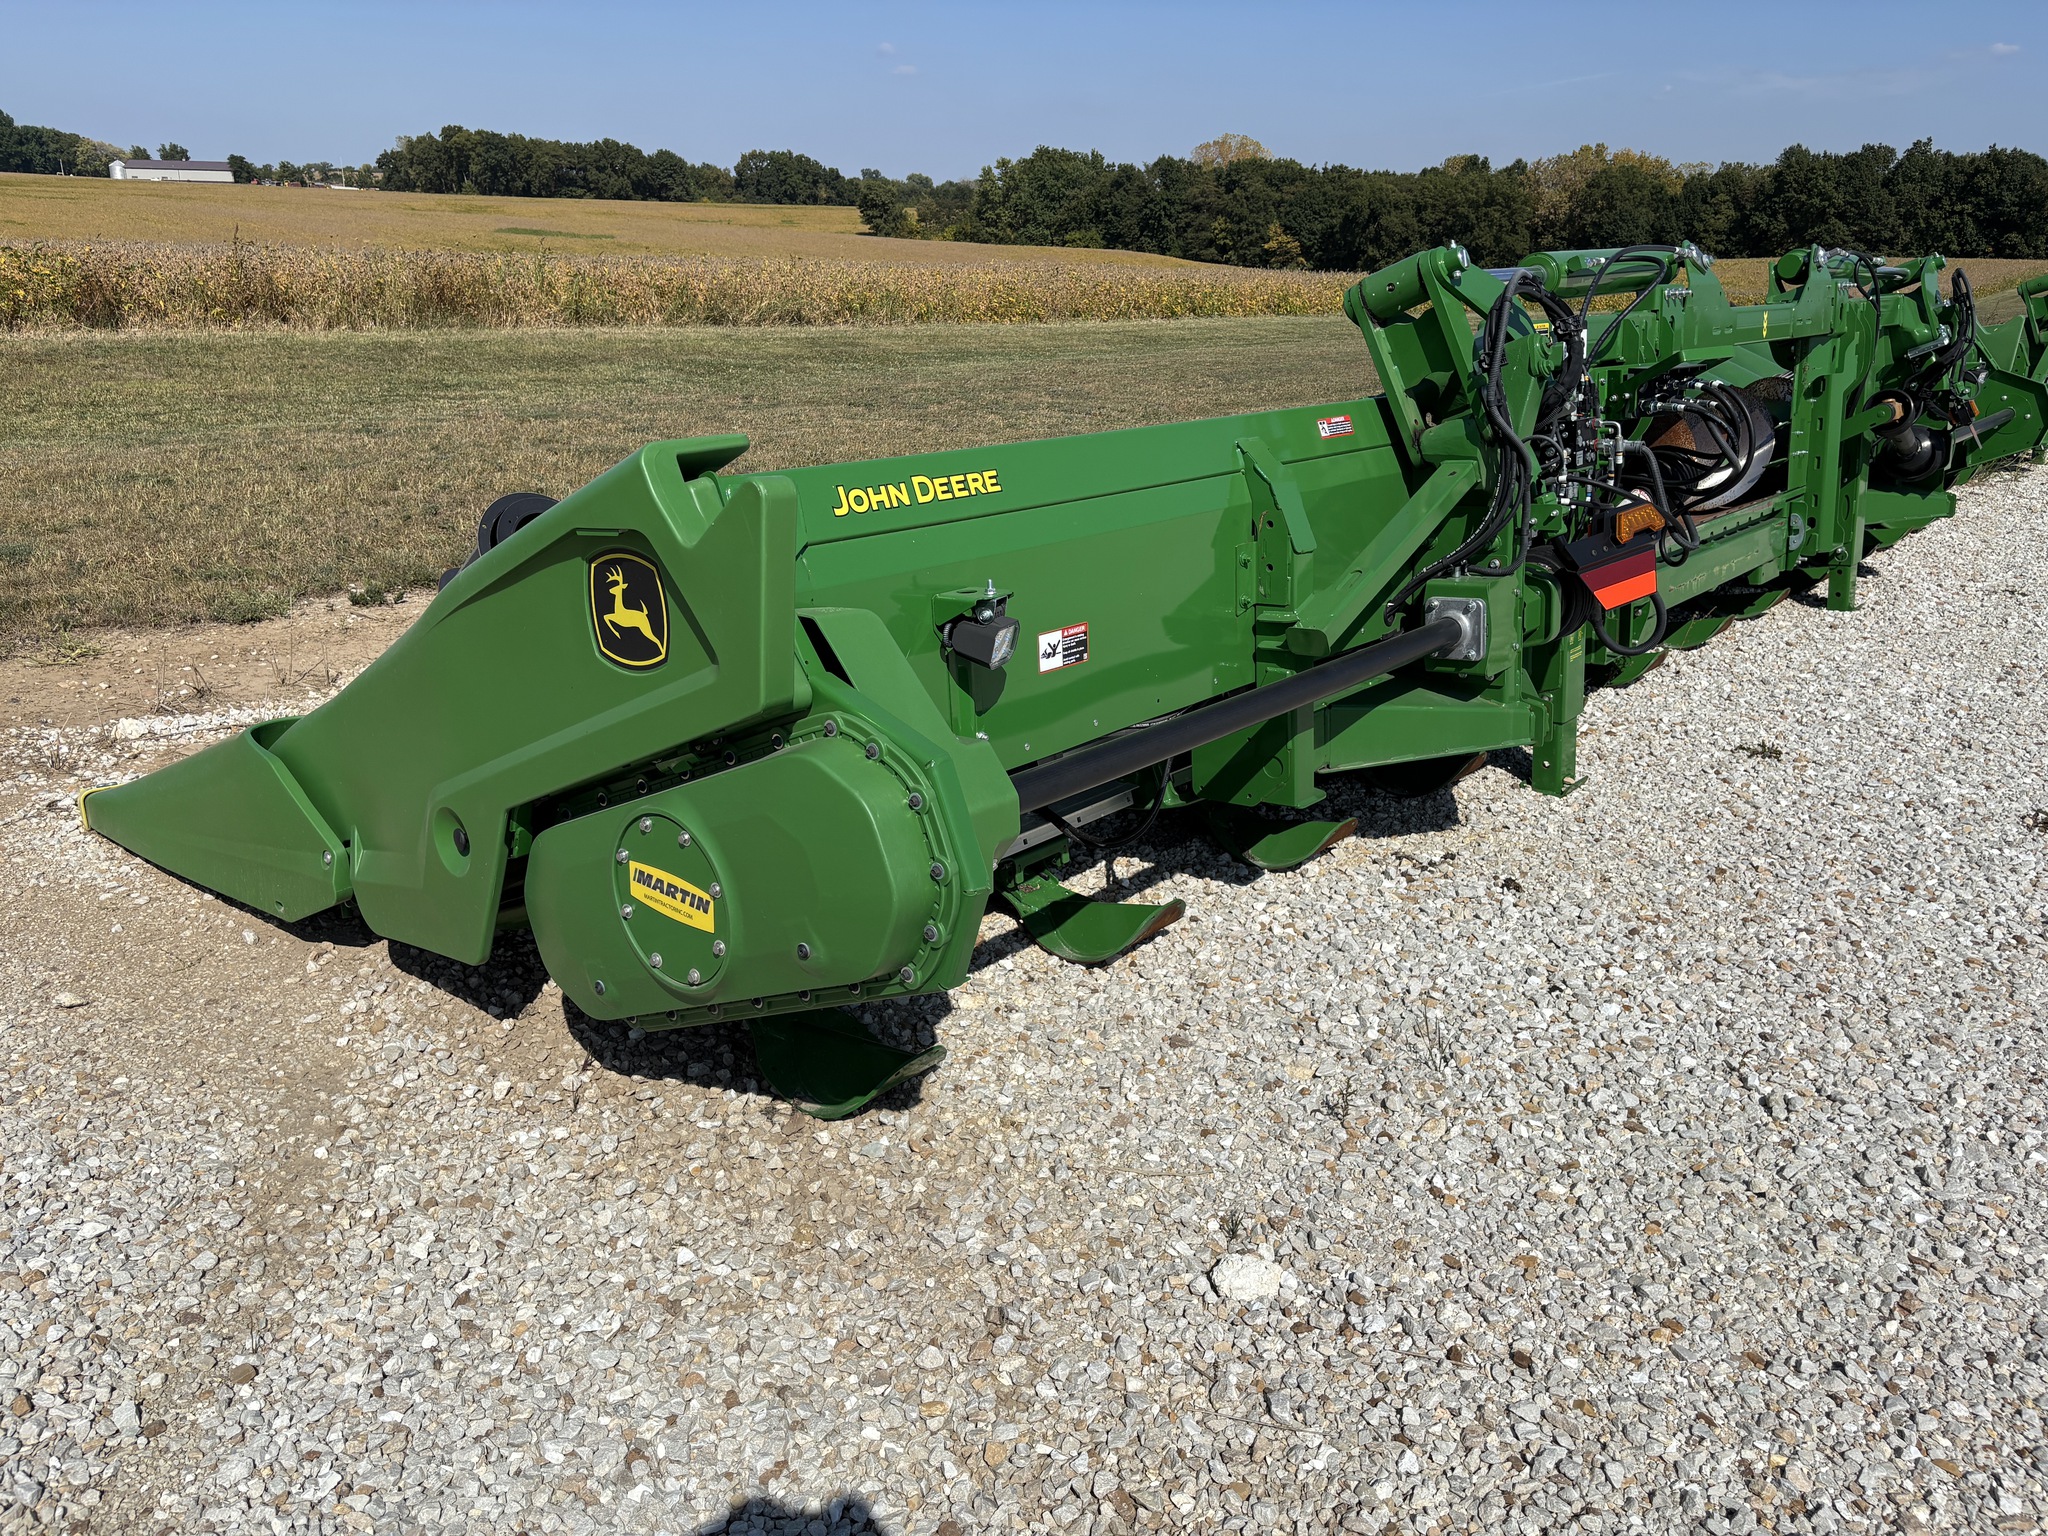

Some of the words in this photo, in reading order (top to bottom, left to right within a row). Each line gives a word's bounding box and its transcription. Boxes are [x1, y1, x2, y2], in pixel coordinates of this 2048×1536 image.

[832, 482, 912, 517] JOHN
[910, 469, 1003, 504] DEERE
[1068, 625, 1085, 635] DANGER
[633, 868, 711, 914] MARTIN
[643, 893, 694, 920] MARTINTRACTORINC.COM
